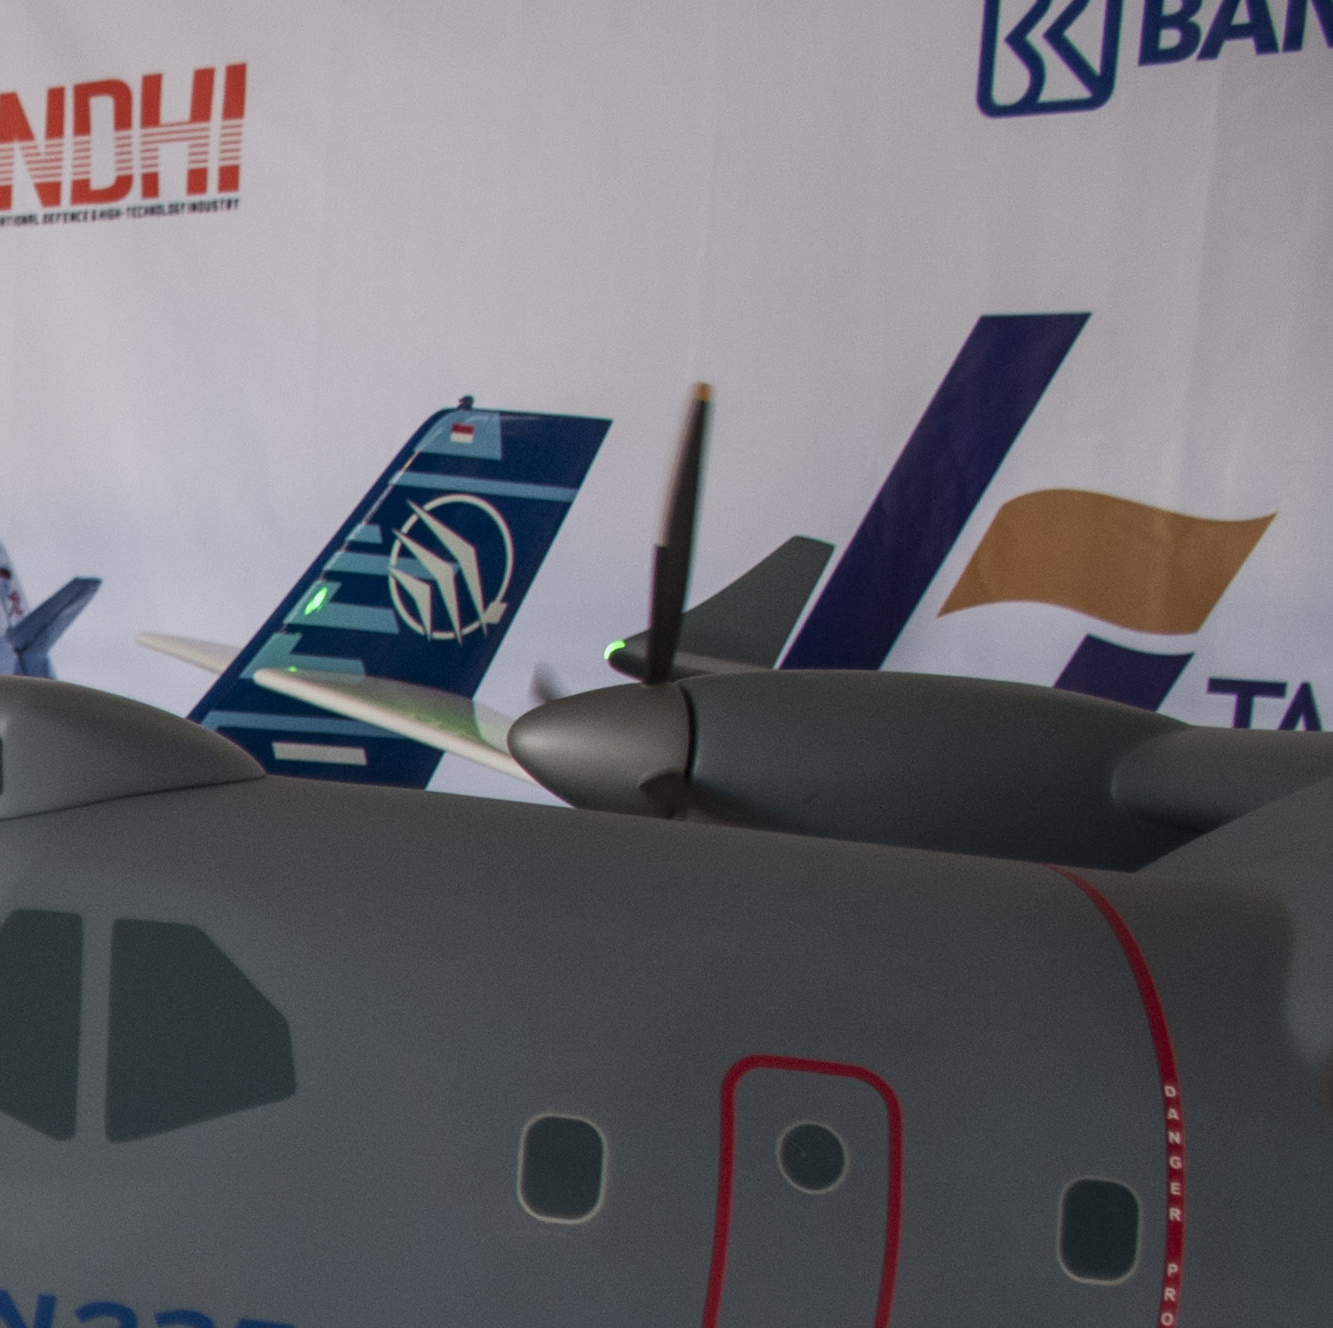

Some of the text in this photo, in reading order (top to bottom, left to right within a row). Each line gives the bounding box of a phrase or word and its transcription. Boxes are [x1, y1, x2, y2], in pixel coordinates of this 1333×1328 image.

[42, 207, 89, 226] DEFENCE
[187, 198, 240, 214] INDUSTRY
[1163, 1085, 1183, 1223] DANGER
